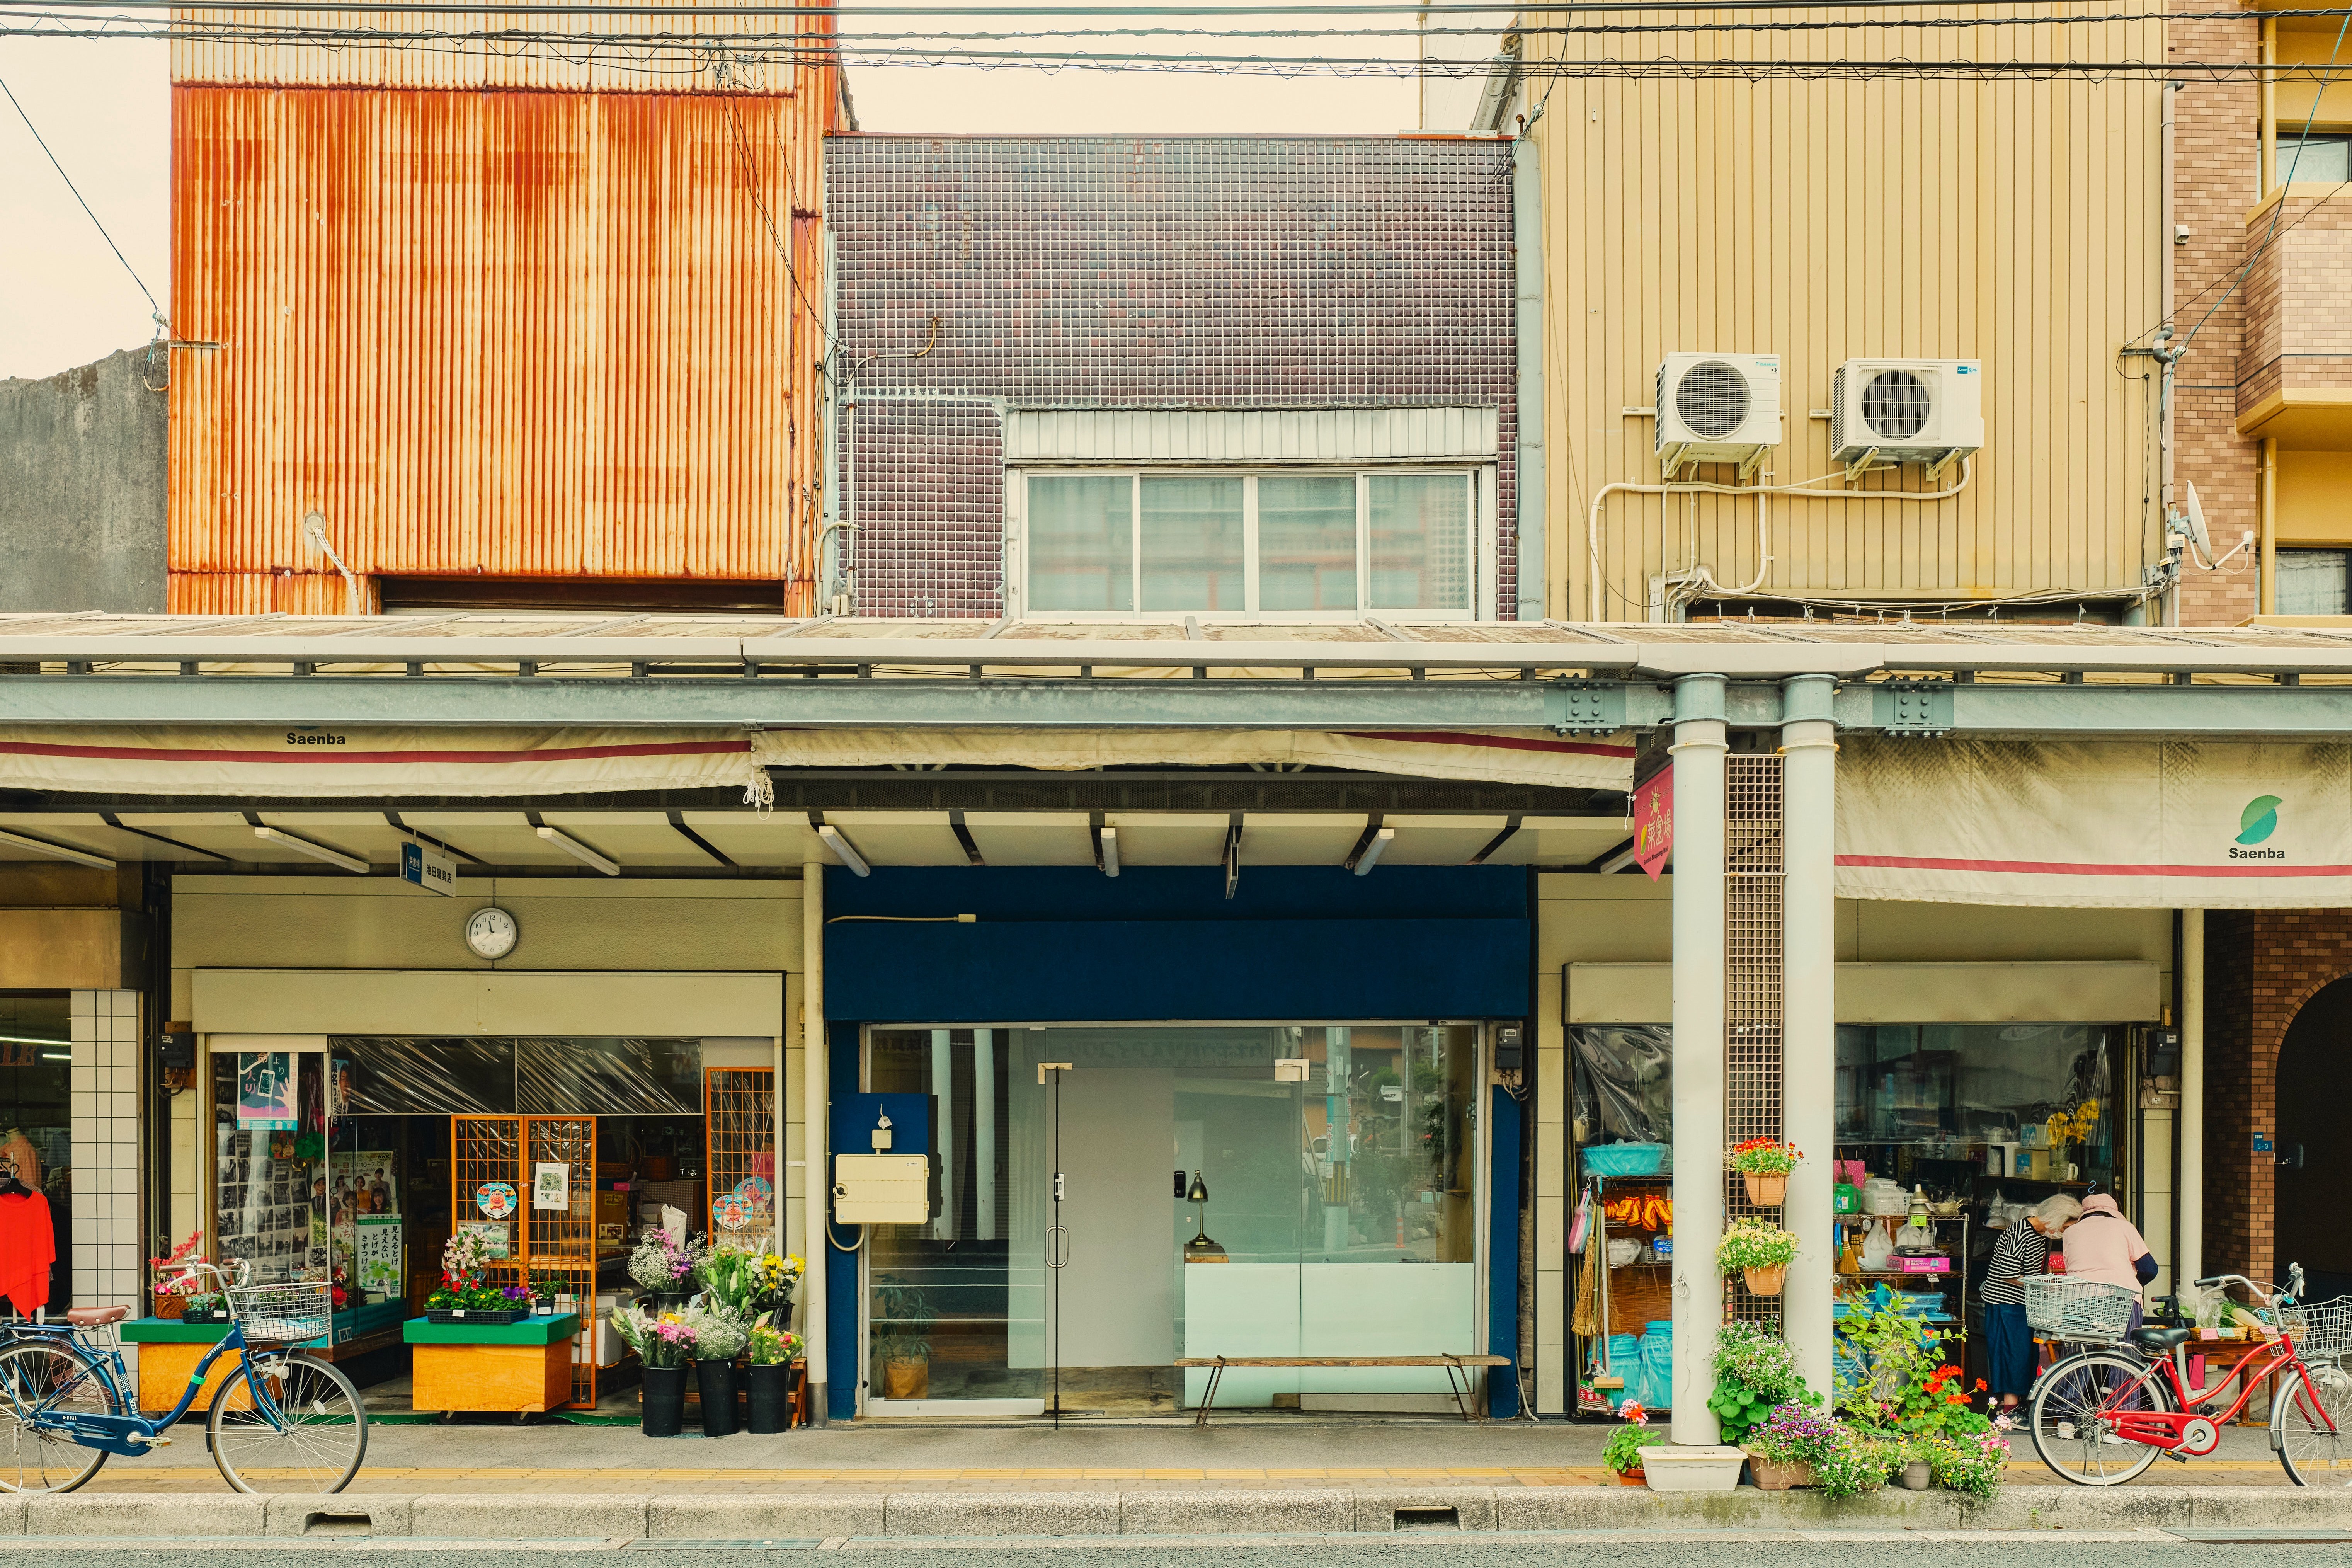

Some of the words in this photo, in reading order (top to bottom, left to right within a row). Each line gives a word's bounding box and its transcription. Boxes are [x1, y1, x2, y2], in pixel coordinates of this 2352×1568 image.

[286, 732, 345, 744] Saenba
[2229, 848, 2285, 858] Saenba
[426, 863, 452, 884] 池田寝具店
[0, 1043, 37, 1066] LE
